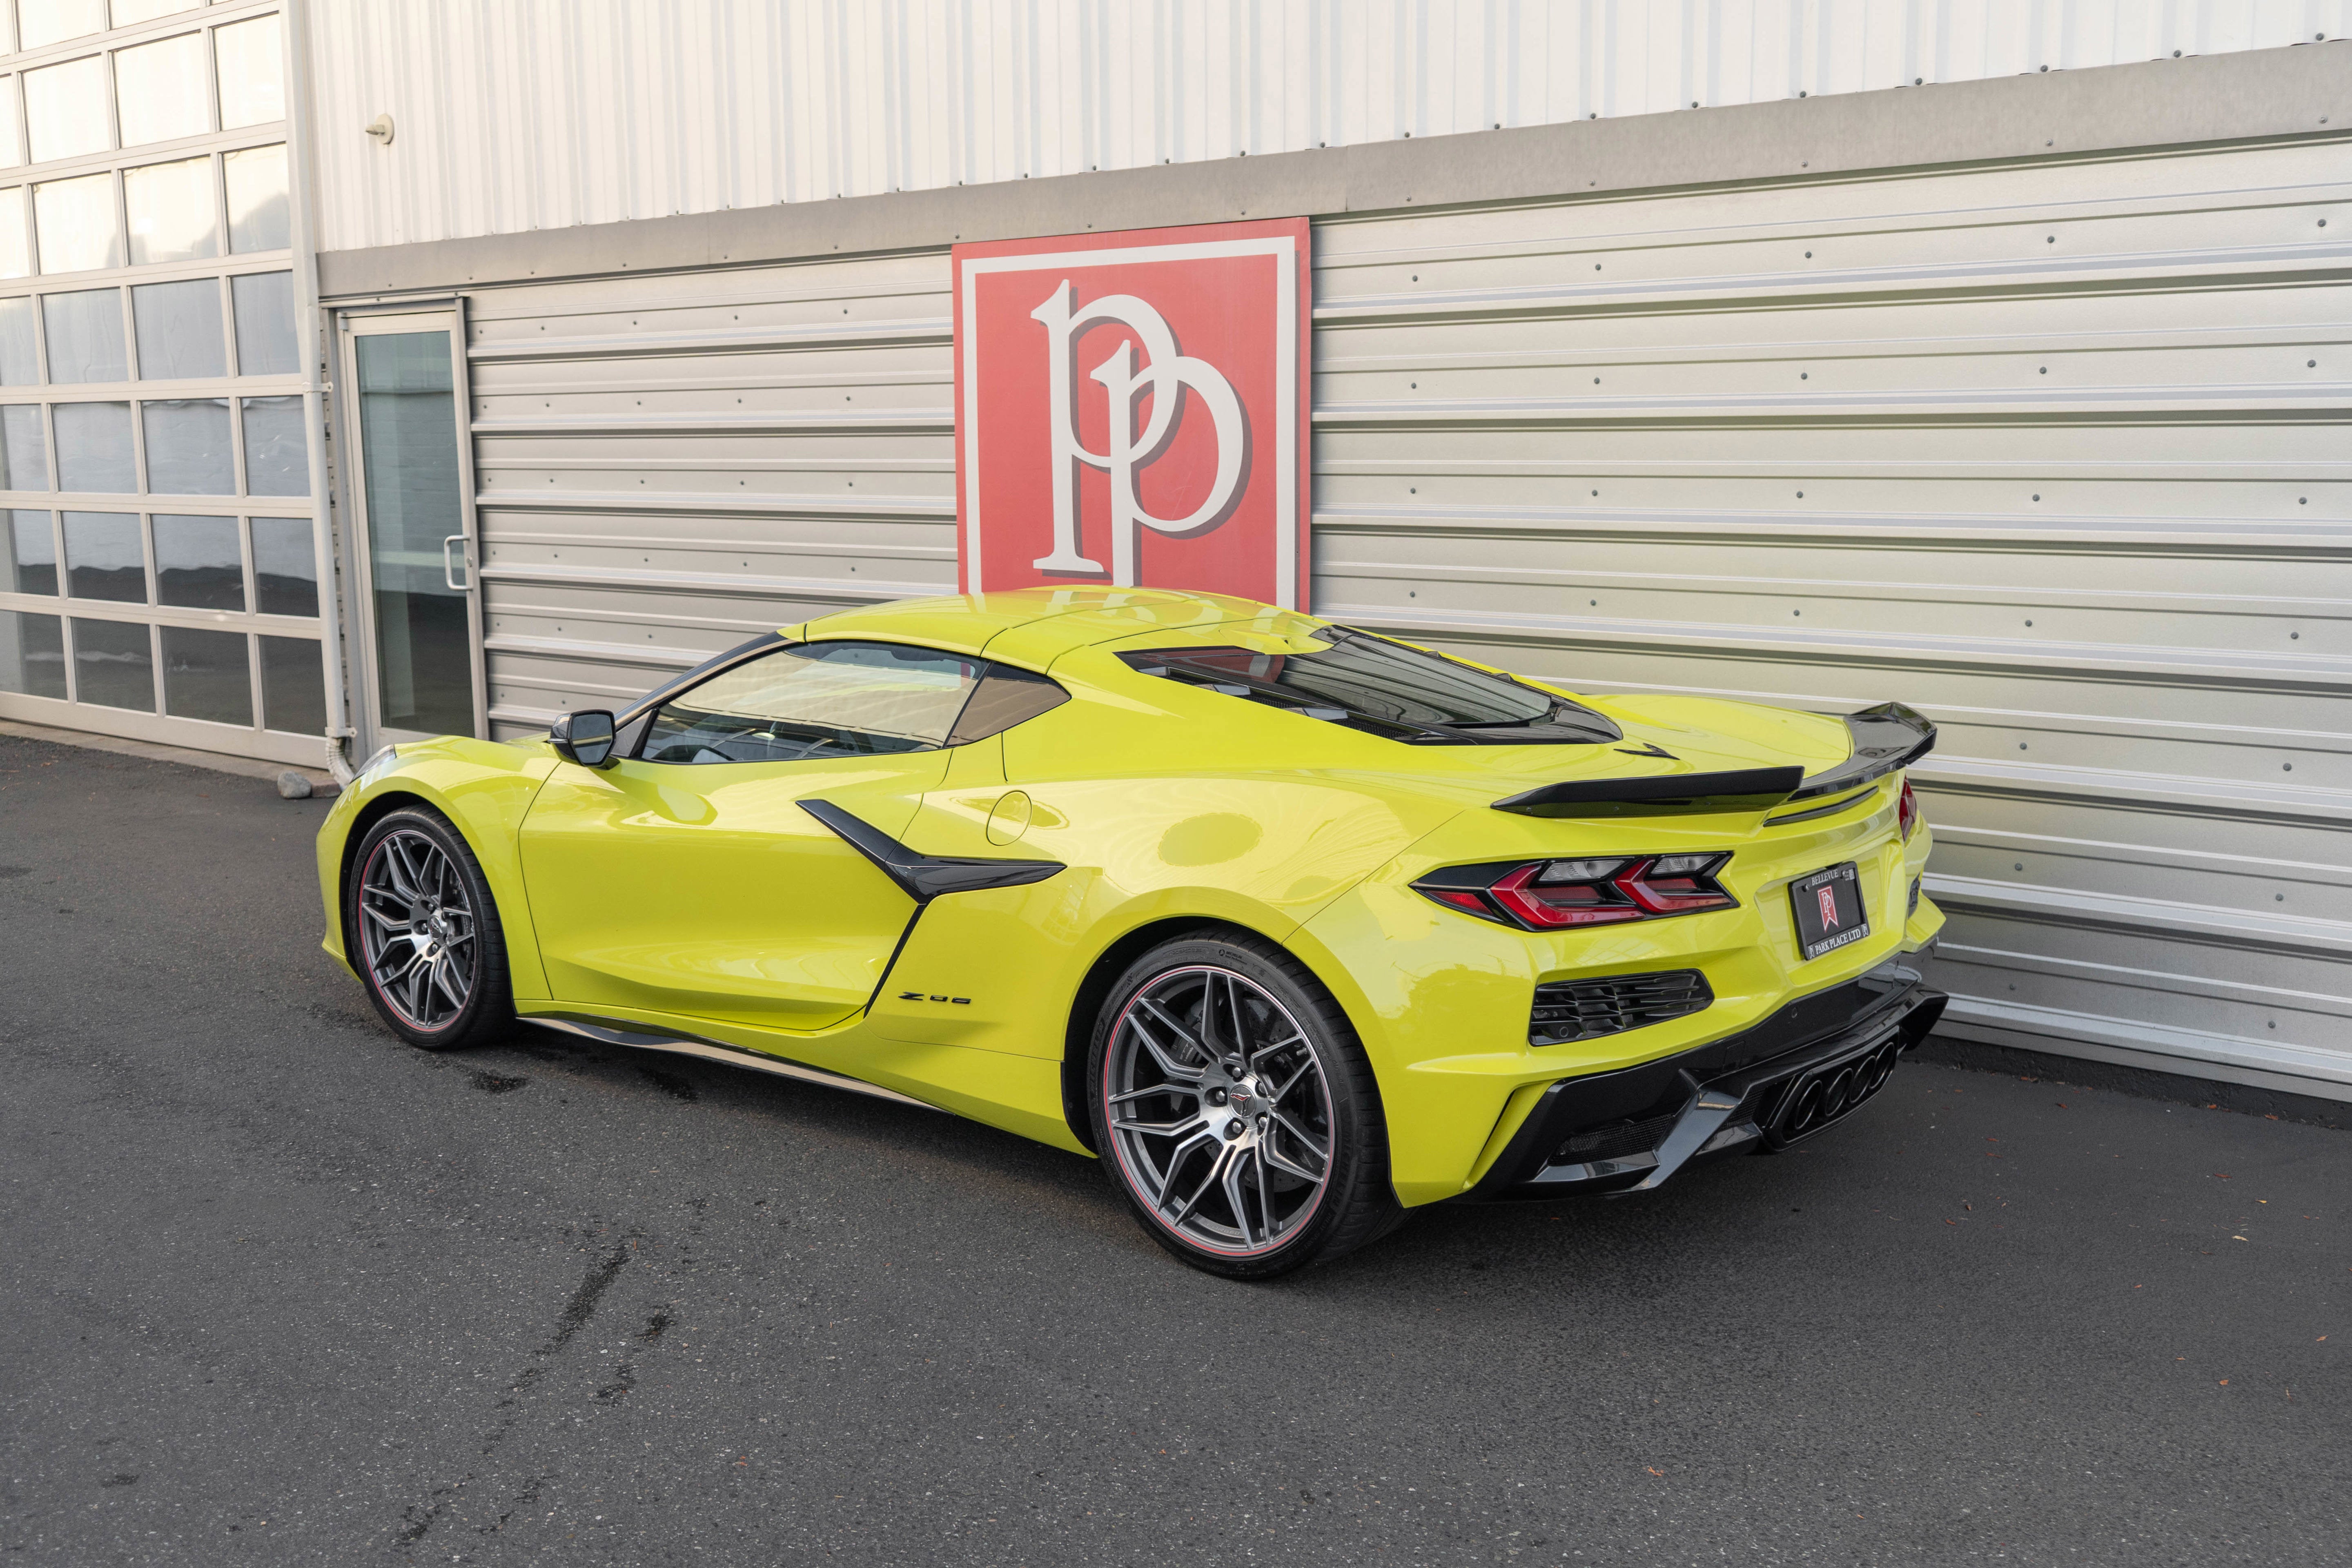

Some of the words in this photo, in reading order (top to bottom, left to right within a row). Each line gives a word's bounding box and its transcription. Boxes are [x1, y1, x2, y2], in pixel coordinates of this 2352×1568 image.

[1811, 869, 1838, 886] BELLEVUE
[1815, 941, 1831, 954] PARK
[1830, 934, 1848, 949] PLACE
[1848, 929, 1861, 941] LTD
[898, 991, 971, 1004] Z06
